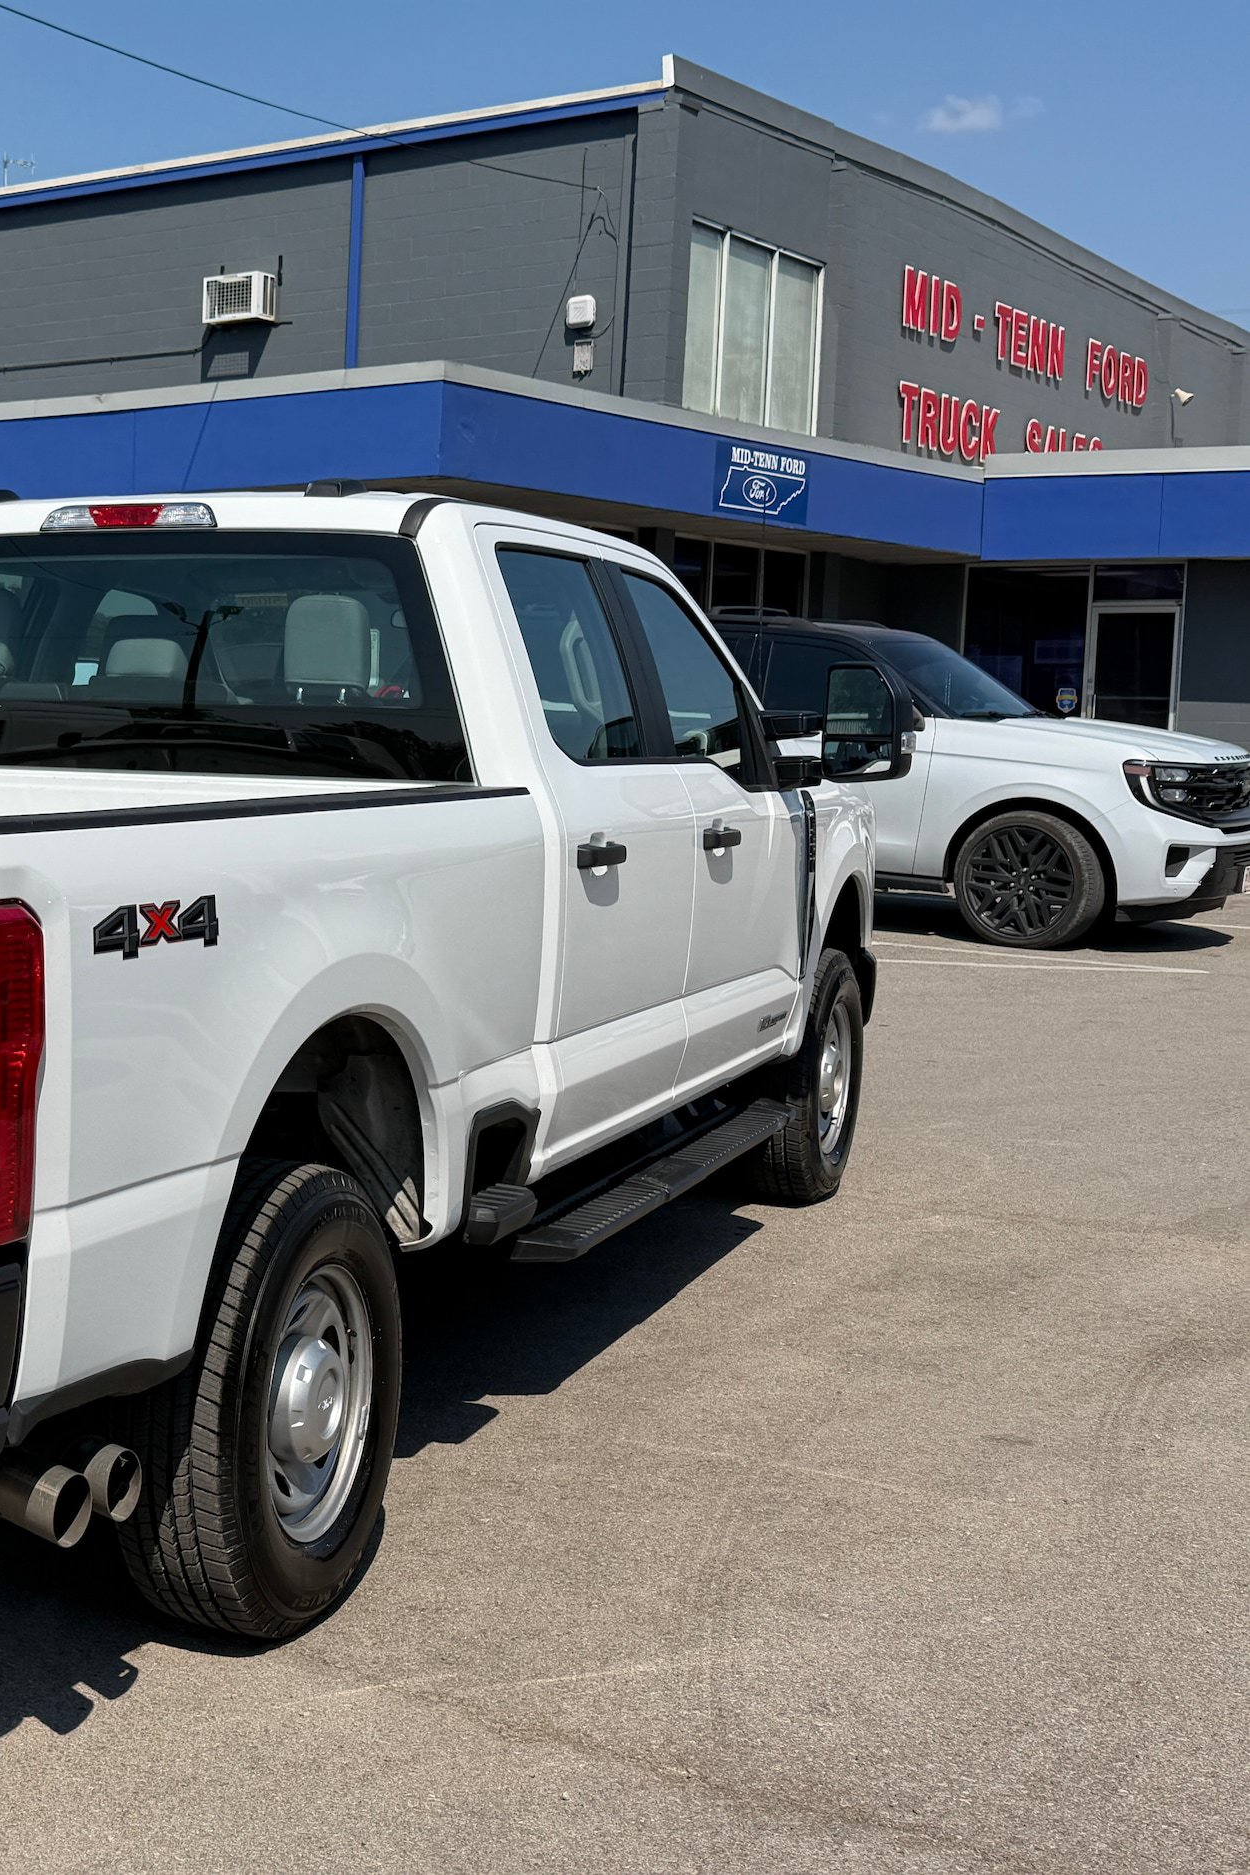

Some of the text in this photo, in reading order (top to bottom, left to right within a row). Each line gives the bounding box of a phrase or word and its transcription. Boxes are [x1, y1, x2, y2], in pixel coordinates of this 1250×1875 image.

[903, 265, 962, 342] MID
[995, 301, 1066, 381] TENN
[1086, 338, 1149, 407] FORD
[731, 446, 806, 476] MID-TENN FORD
[900, 380, 1000, 463] TRUCK
